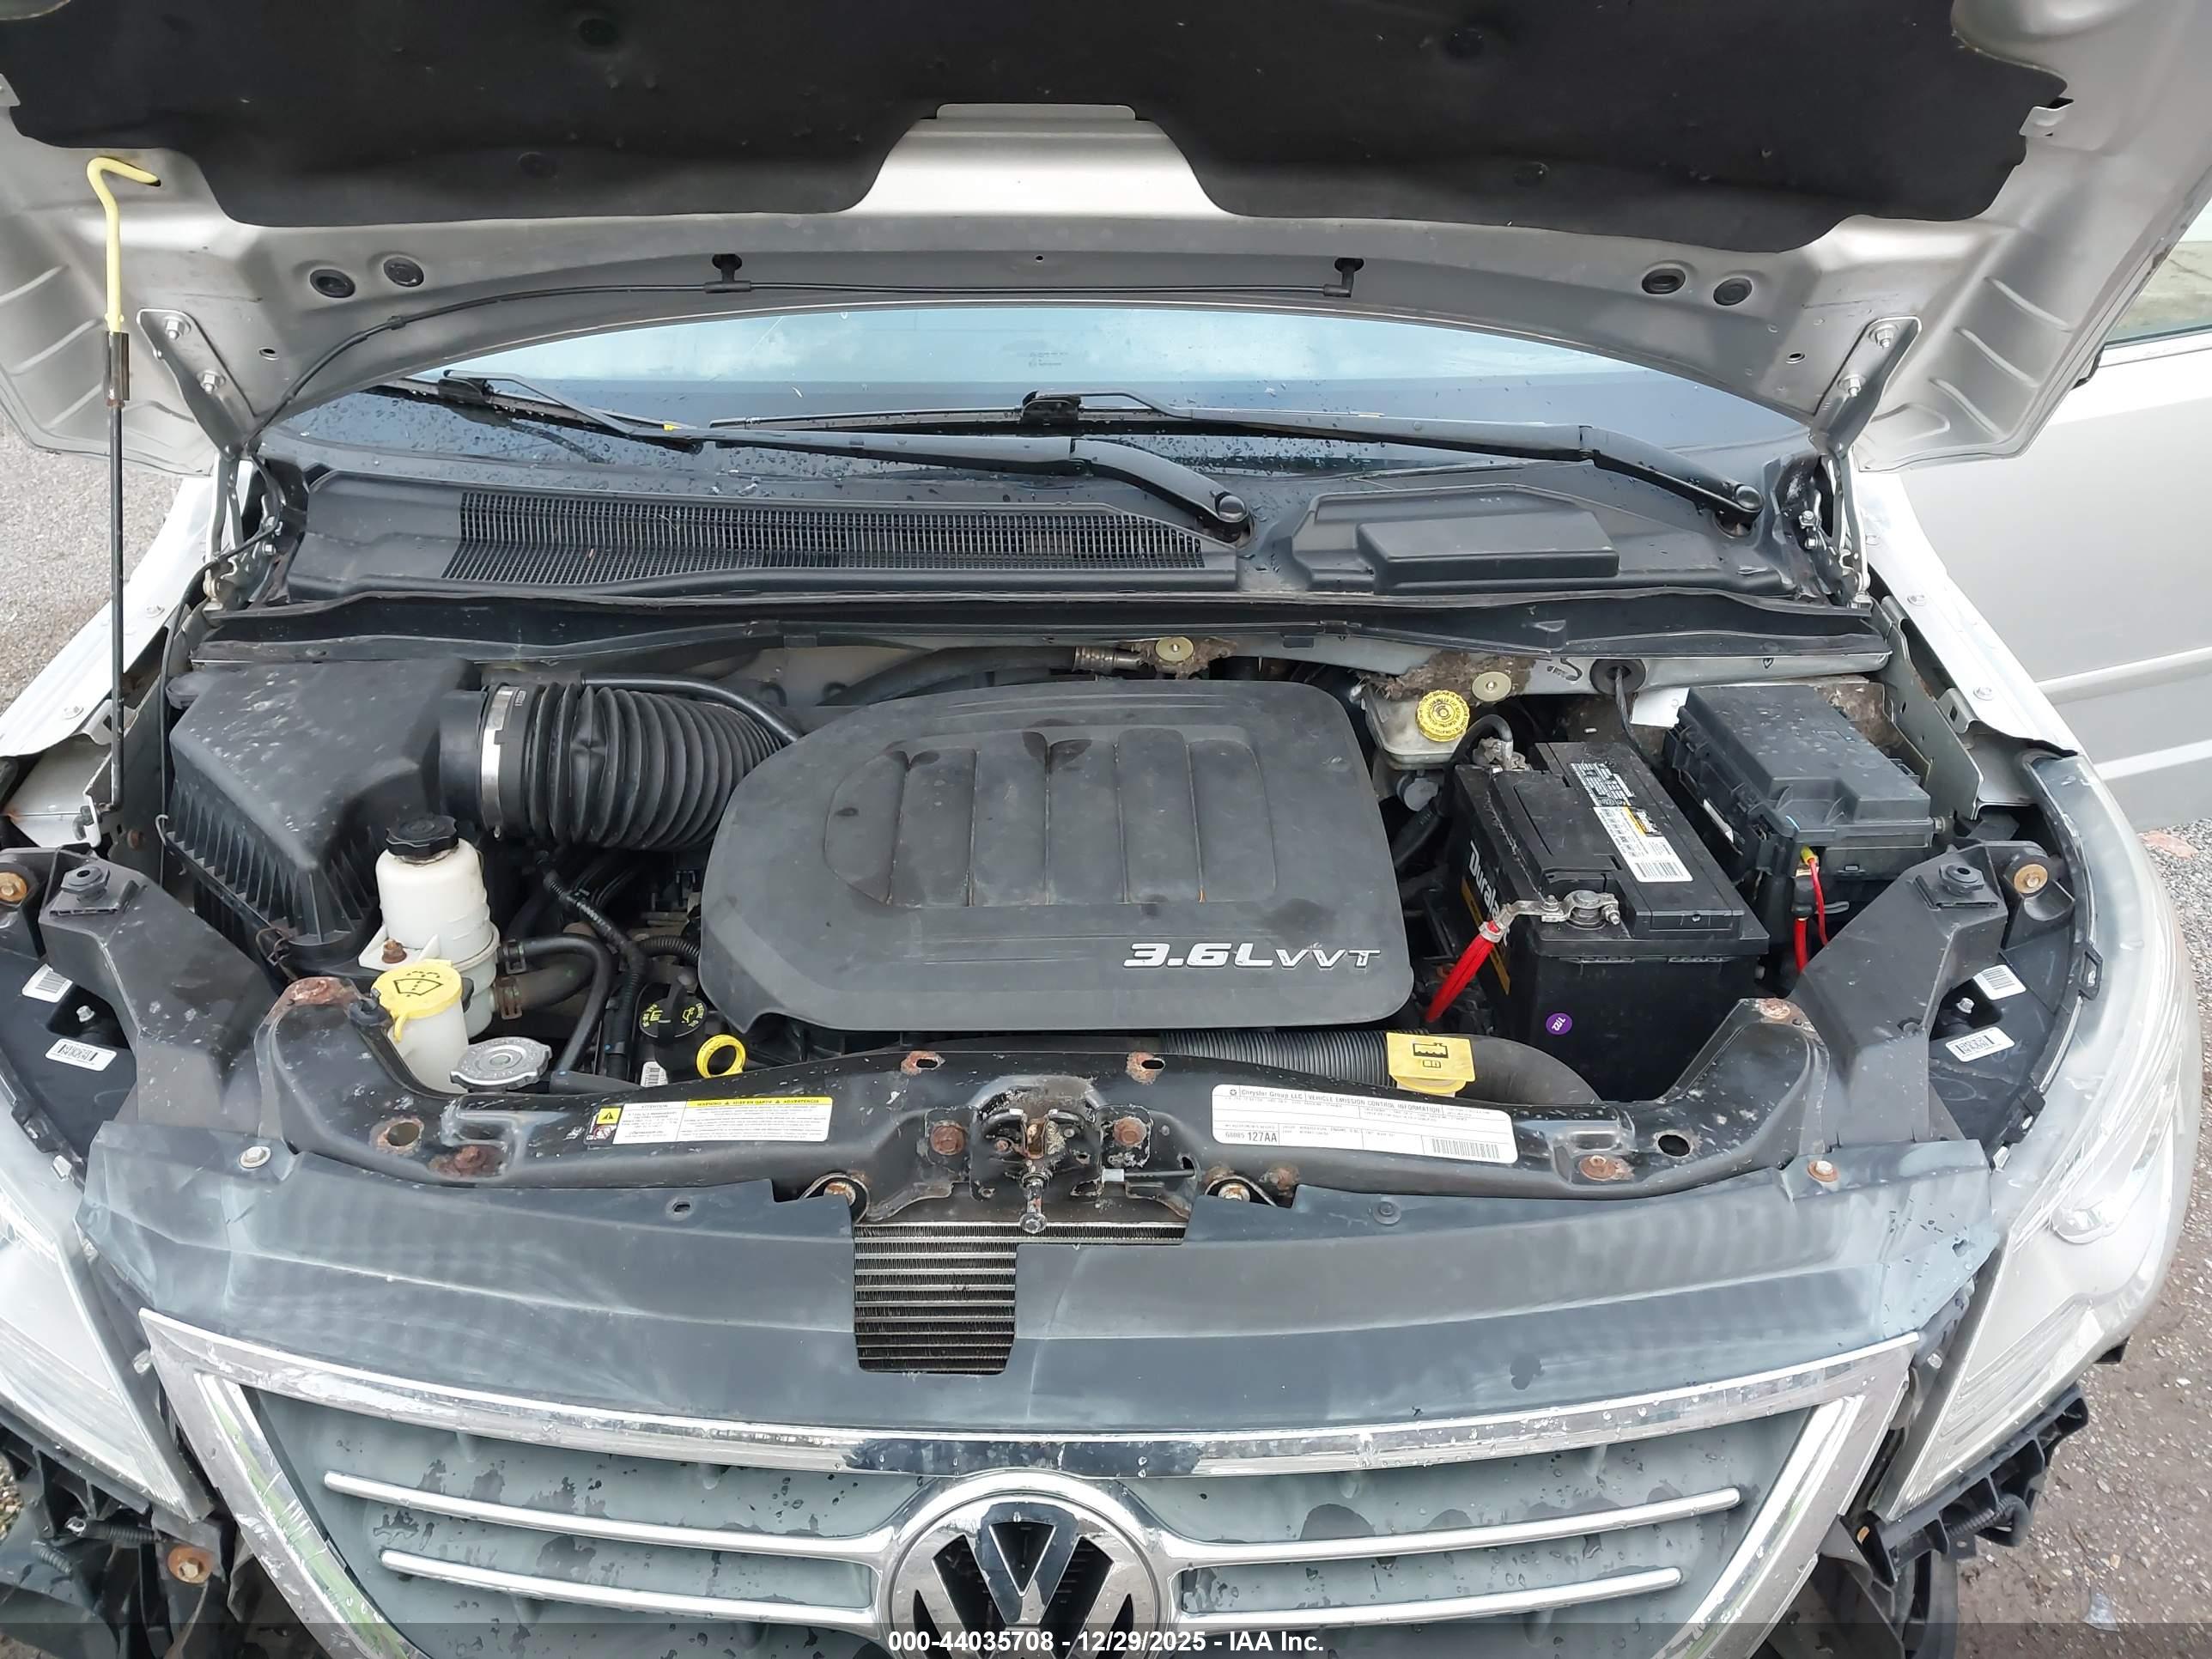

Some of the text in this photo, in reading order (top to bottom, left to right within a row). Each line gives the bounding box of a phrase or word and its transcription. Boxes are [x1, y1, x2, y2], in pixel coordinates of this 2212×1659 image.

[1241, 1089, 1267, 1097] Chrysler
[1269, 1091, 1288, 1099] Group
[1335, 1097, 1365, 1106] EMISSION
[1367, 1100, 1395, 1109] CONTROL
[1397, 1103, 1441, 1114] INFORMATION
[1248, 1132, 1278, 1142] 127AA
